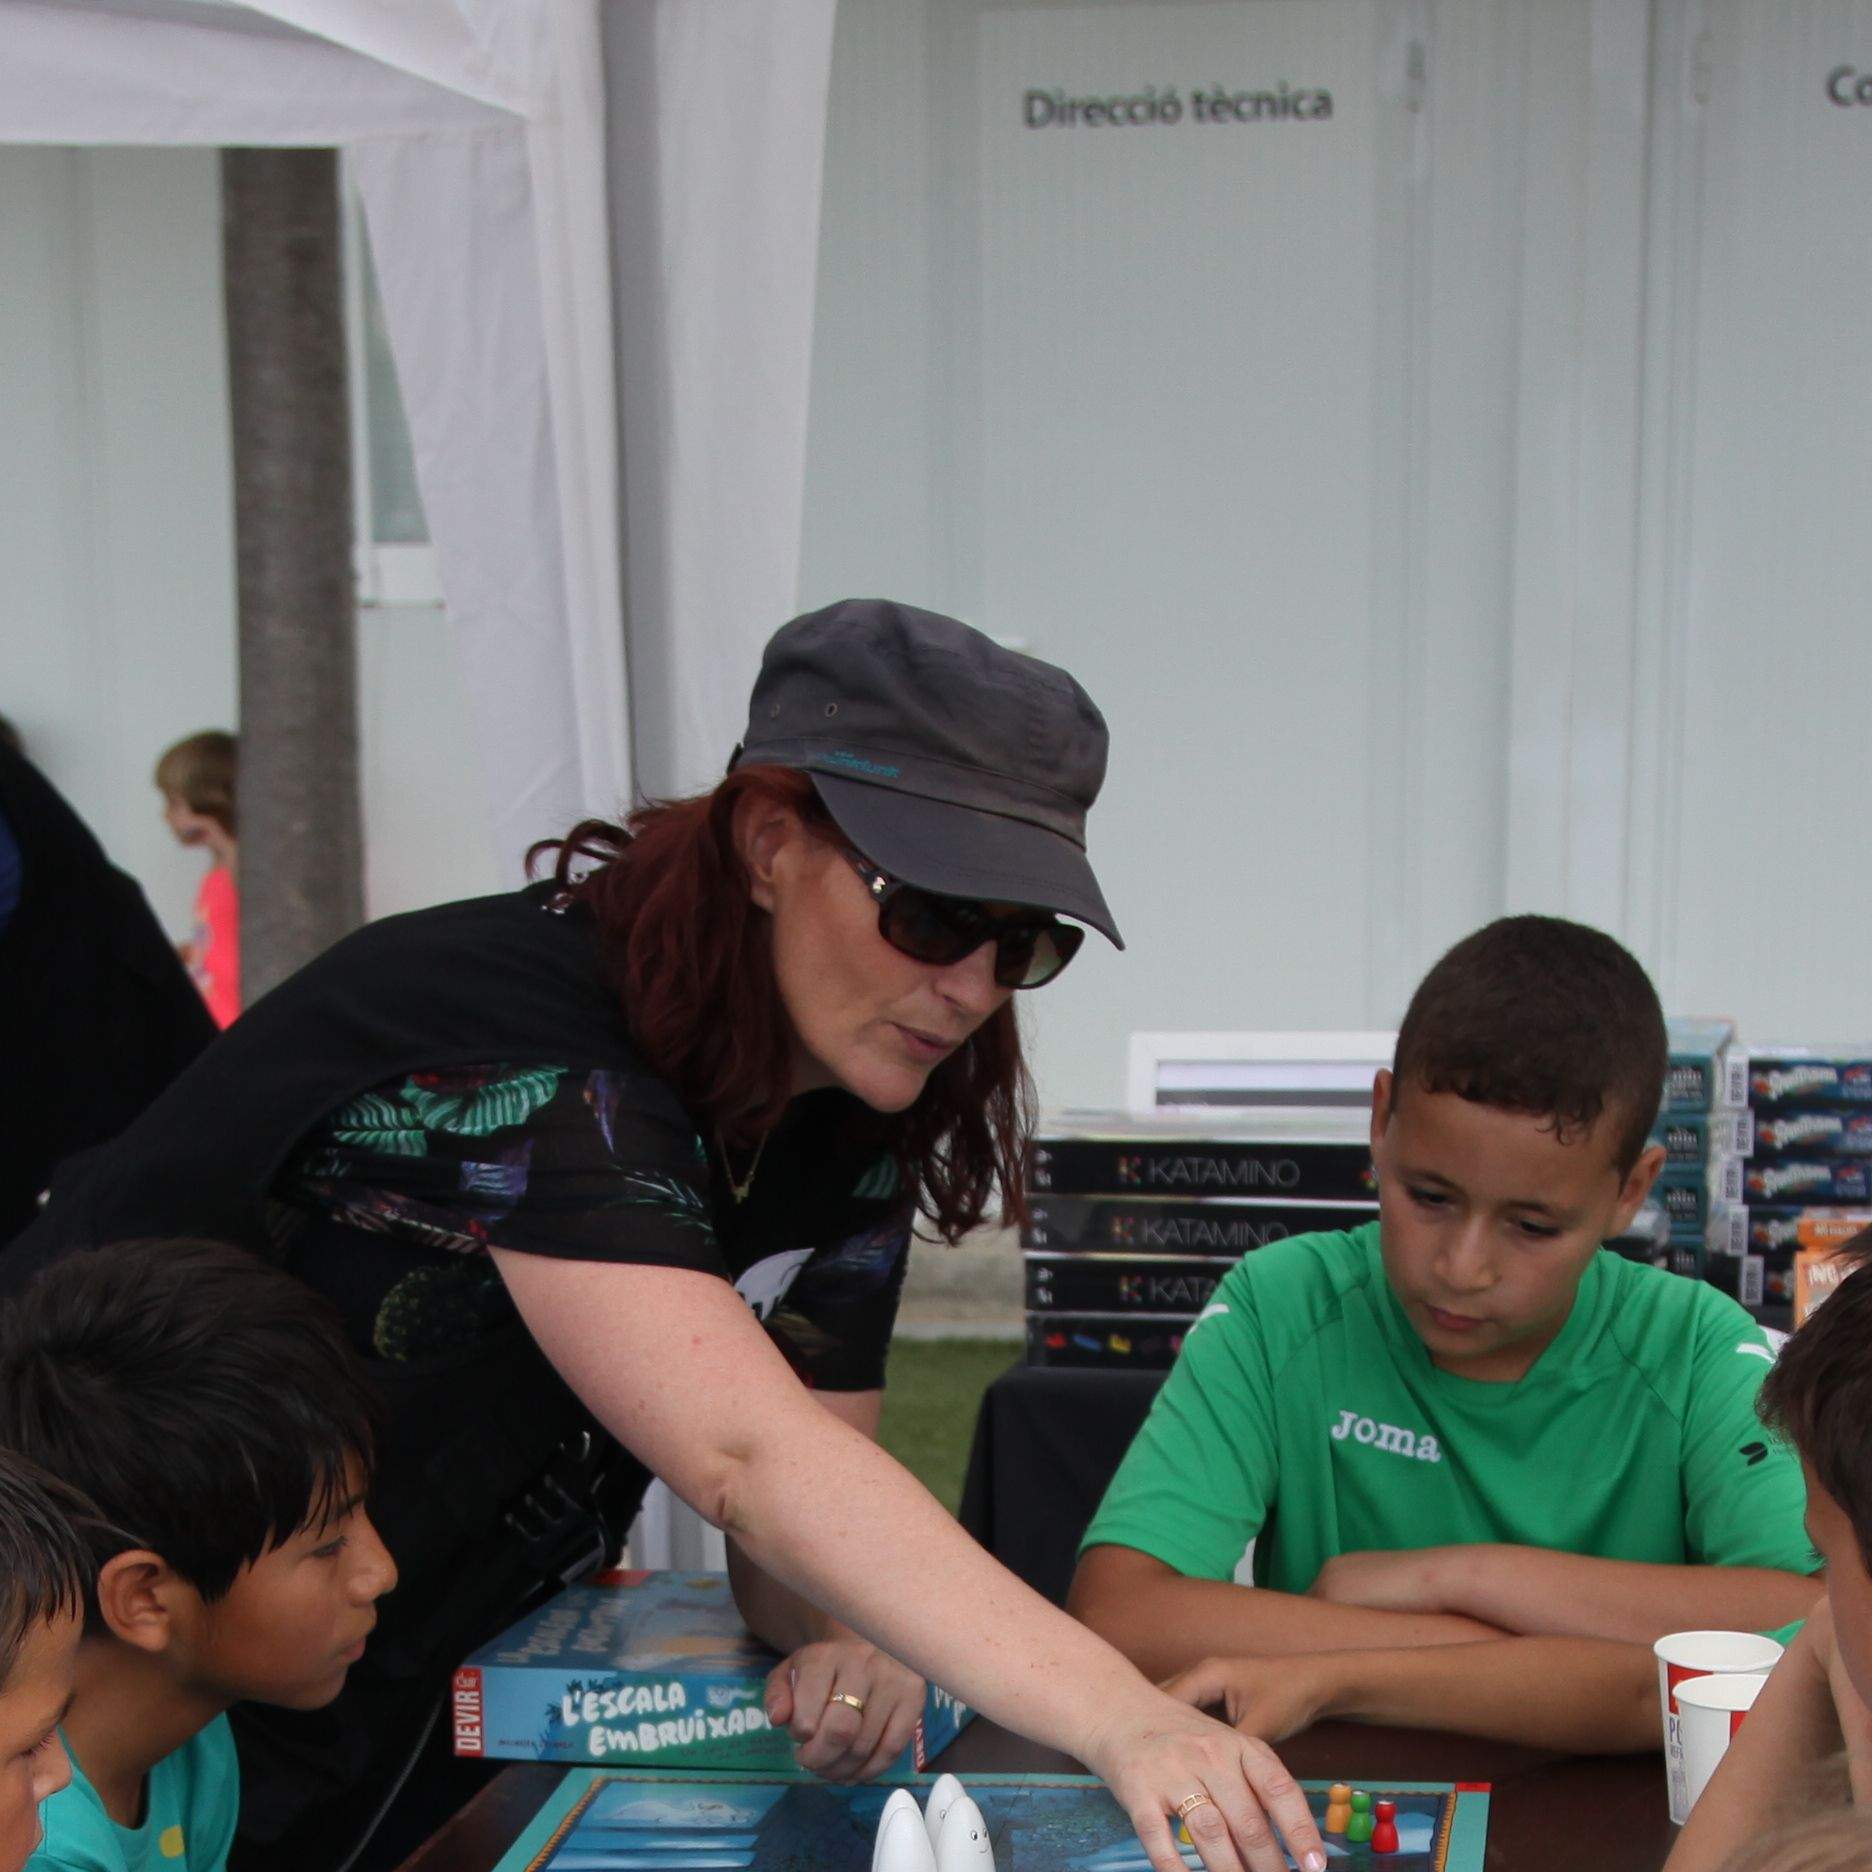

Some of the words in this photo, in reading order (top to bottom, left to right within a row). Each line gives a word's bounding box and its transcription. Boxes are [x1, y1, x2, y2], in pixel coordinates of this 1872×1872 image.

[1024, 84, 1183, 128] Direcció
[1191, 80, 1334, 123] tècnica
[1148, 1156, 1301, 1188] KATAMINO
[1141, 1218, 1290, 1248] KATAMINO
[454, 1690, 482, 1751] DEVIR
[560, 1680, 688, 1727] L'ESCALA
